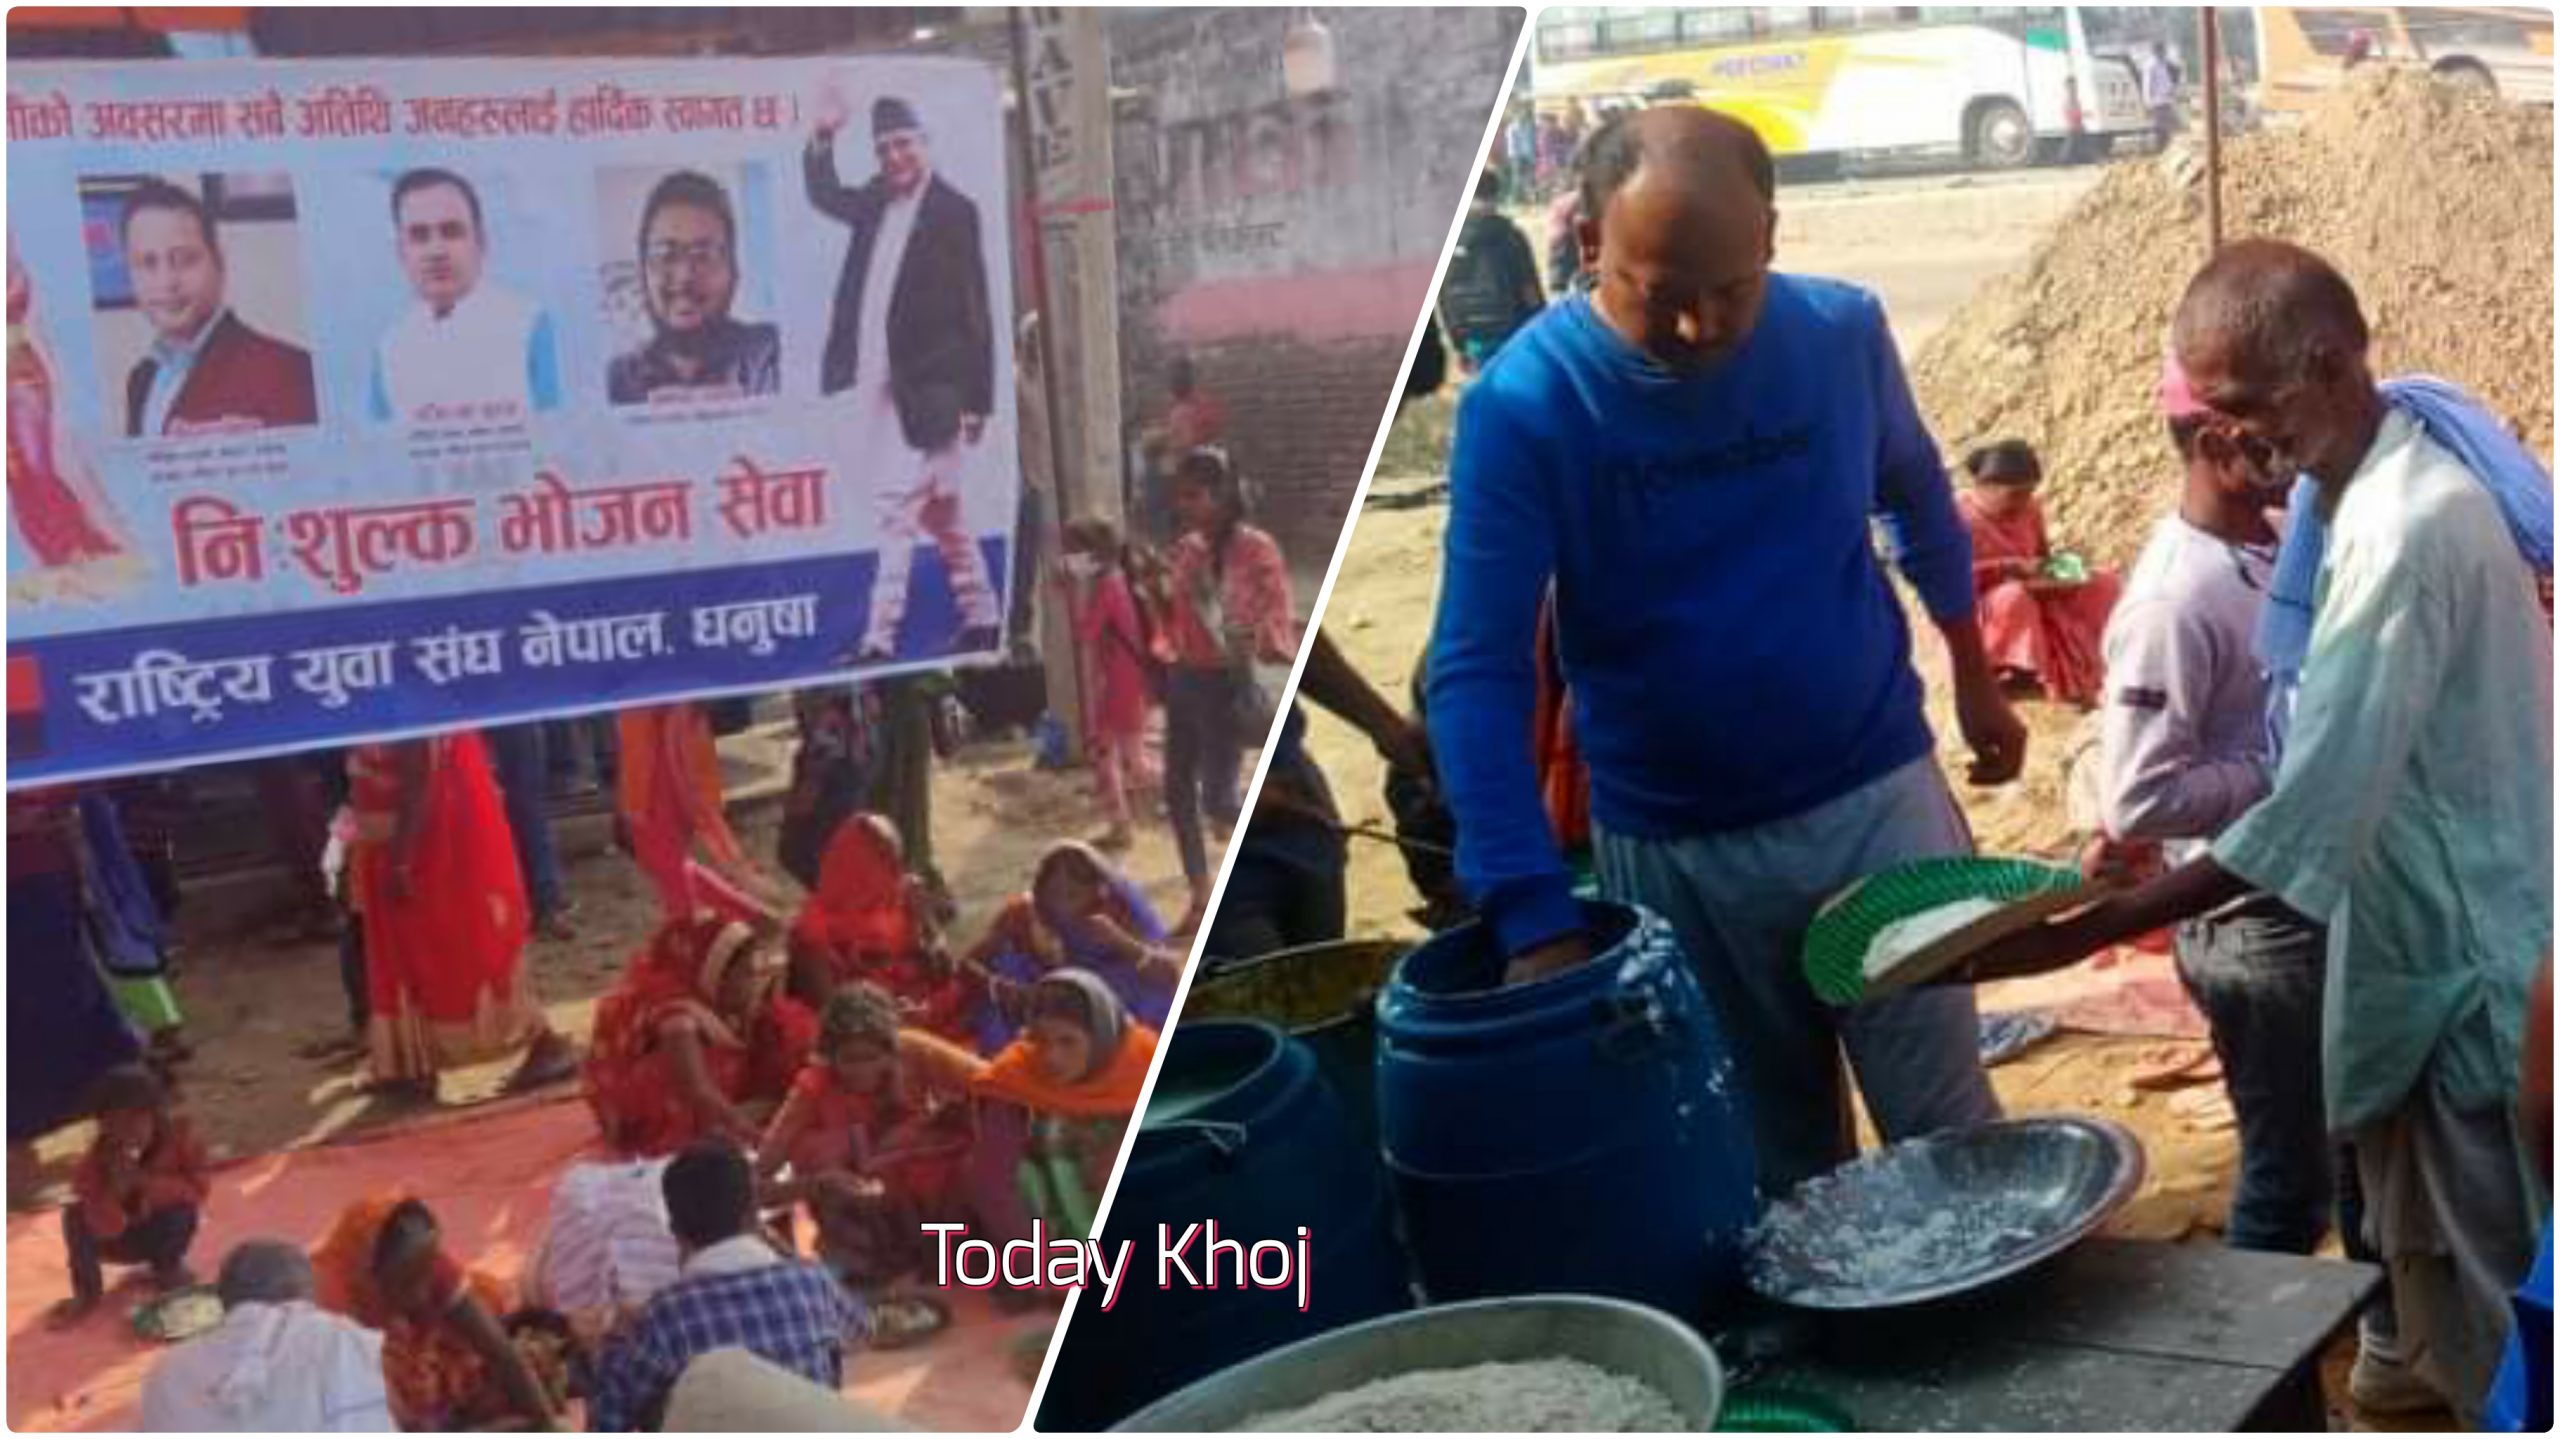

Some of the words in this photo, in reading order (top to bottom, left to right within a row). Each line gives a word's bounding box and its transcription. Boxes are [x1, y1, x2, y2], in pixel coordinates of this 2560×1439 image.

[498, 471, 693, 552] भोजन
[715, 455, 828, 538] सेवा
[291, 640, 395, 706] युवा
[412, 626, 504, 685] संघ
[691, 593, 820, 655] धनुषा
